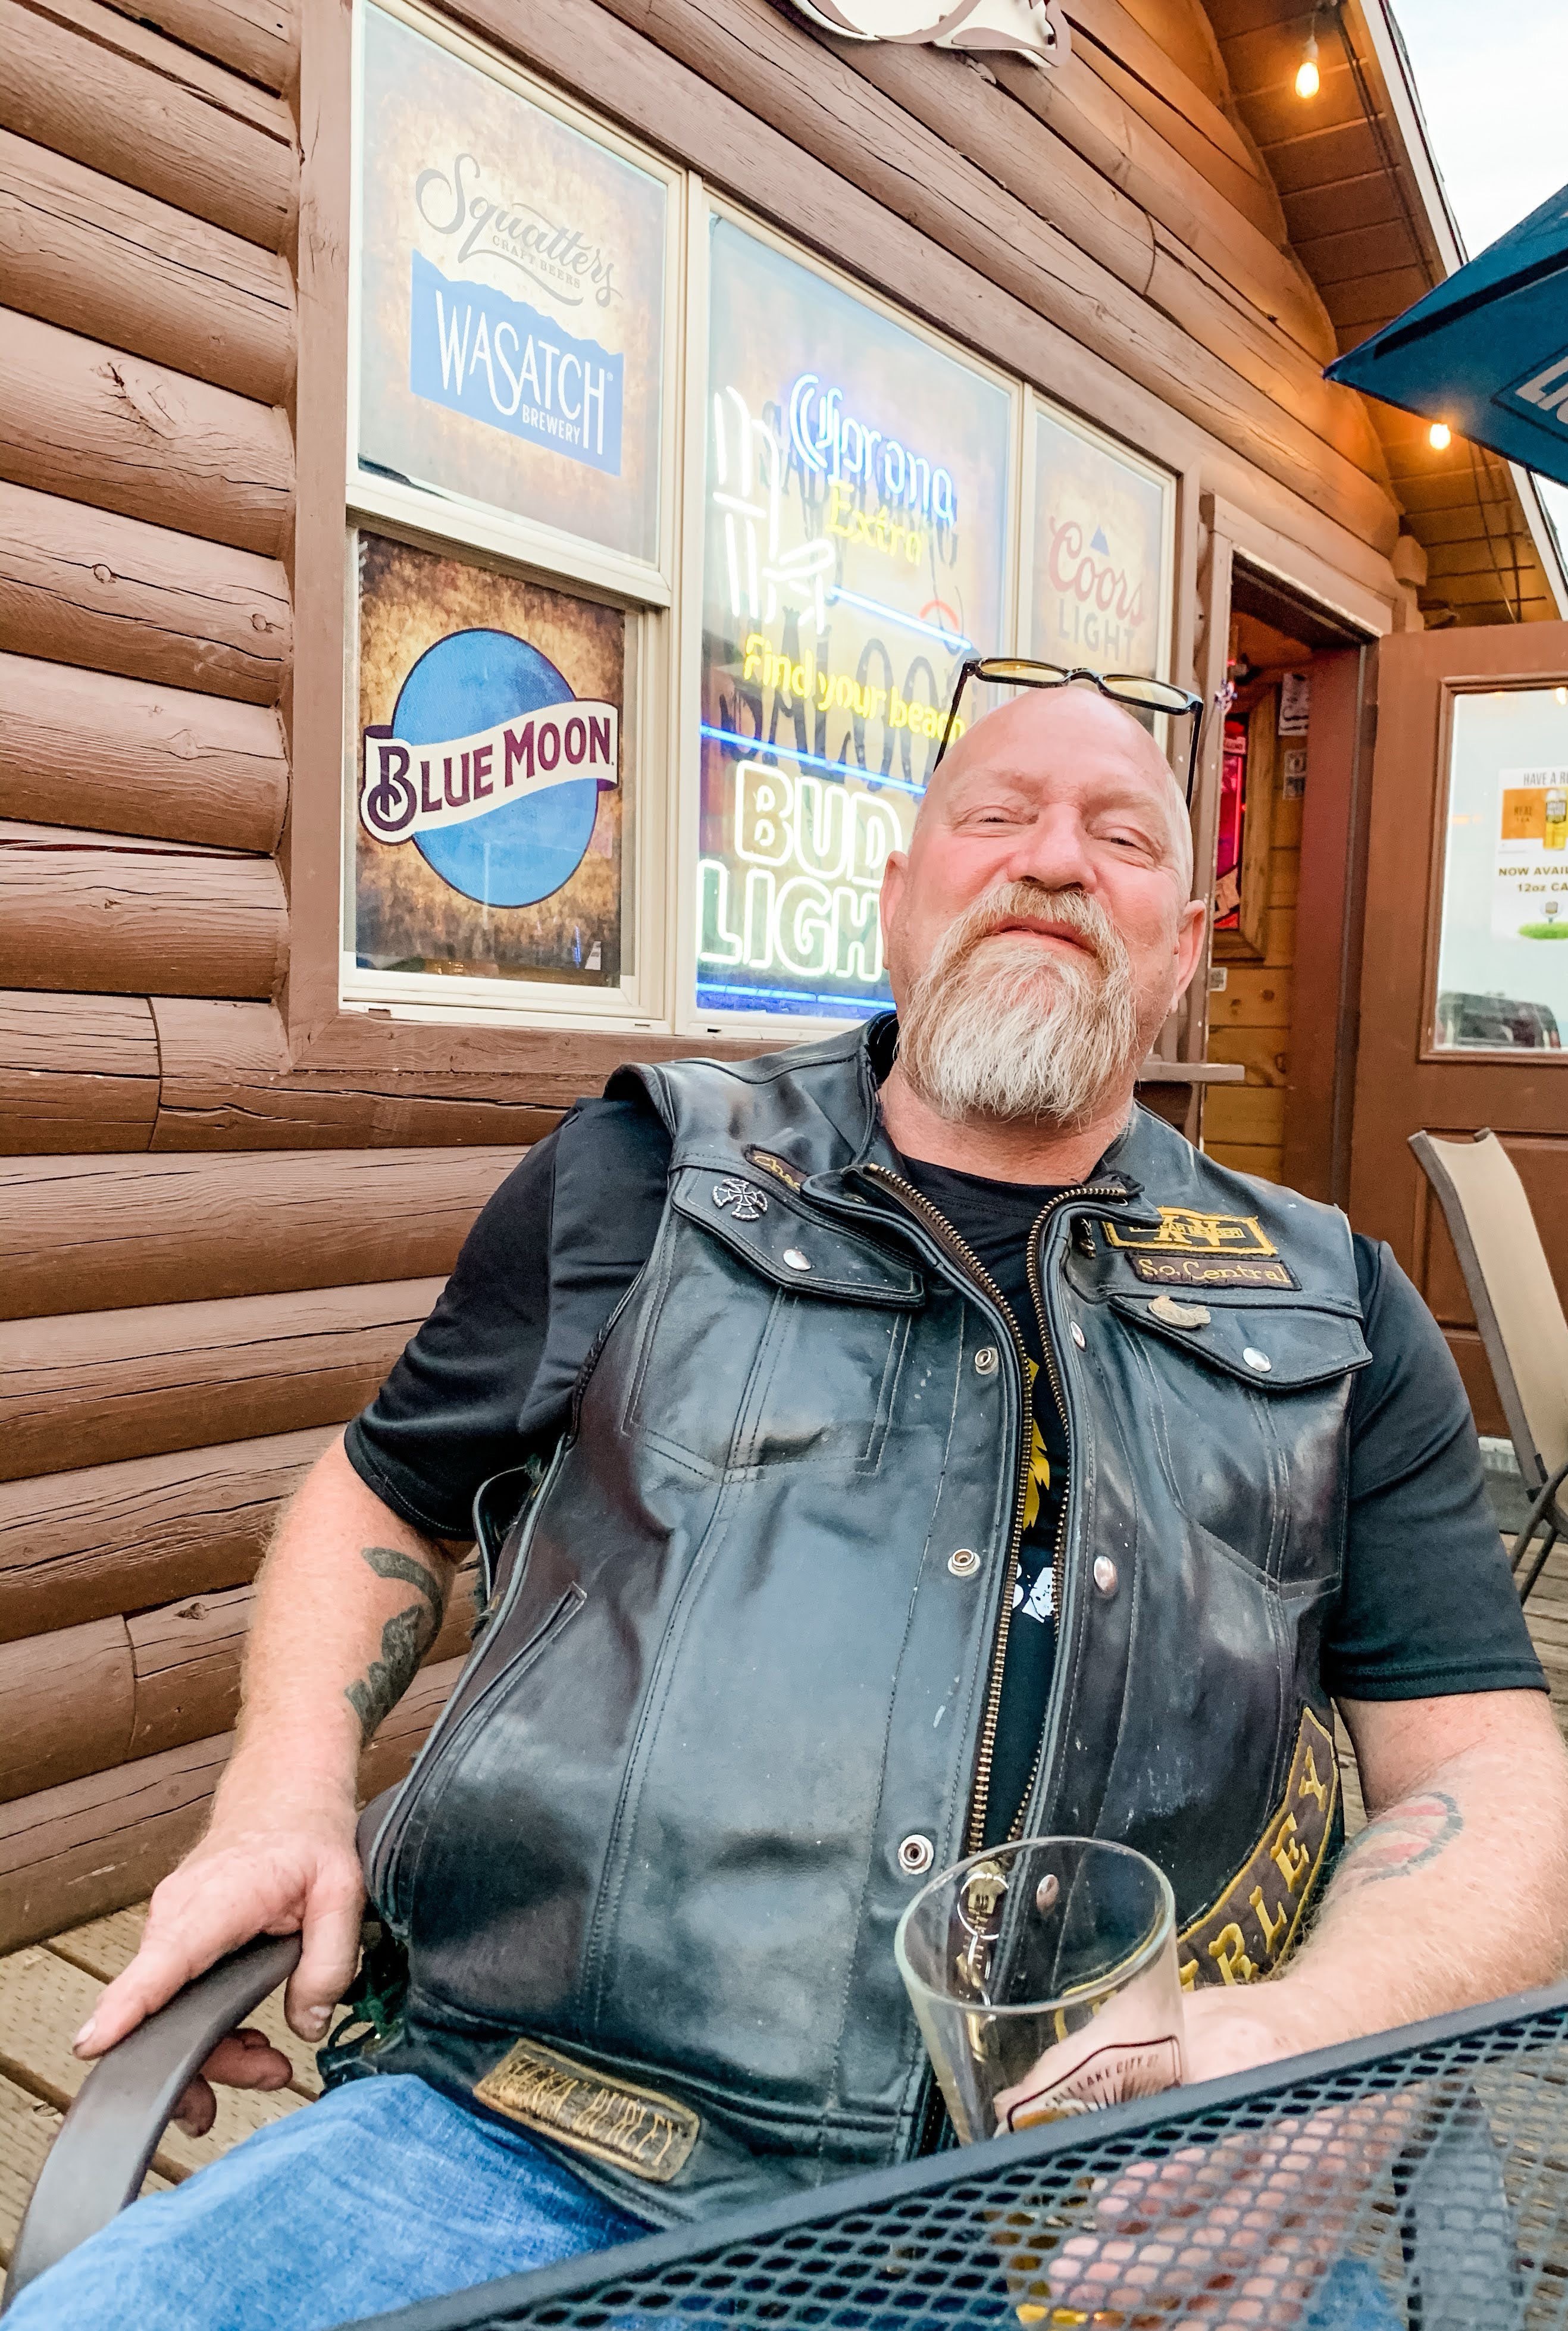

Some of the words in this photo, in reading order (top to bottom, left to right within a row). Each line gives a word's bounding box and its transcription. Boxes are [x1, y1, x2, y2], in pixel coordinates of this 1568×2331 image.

[415, 152, 624, 307] Squatters
[492, 234, 536, 265] CRAFT
[540, 258, 581, 289] BEERS
[436, 289, 605, 455] WASATCH
[522, 403, 581, 445] BREWERY
[789, 373, 956, 528] Corona
[825, 479, 923, 567] Extra
[1049, 515, 1145, 627] Coors
[743, 633, 813, 699] Find
[818, 671, 887, 719] your
[1059, 599, 1135, 667] LIGHT
[367, 744, 493, 831] BLUE
[504, 716, 611, 788] MOON
[1523, 772, 1547, 786] HAVE
[1550, 772, 1556, 784] A
[735, 759, 902, 887] BUD
[1499, 866, 1529, 876] NOW
[1518, 883, 1545, 892] 12oz
[696, 859, 884, 982] LIGH
[1182, 1261, 1291, 1284] Central
[1188, 1226, 1242, 1238] MEBER
